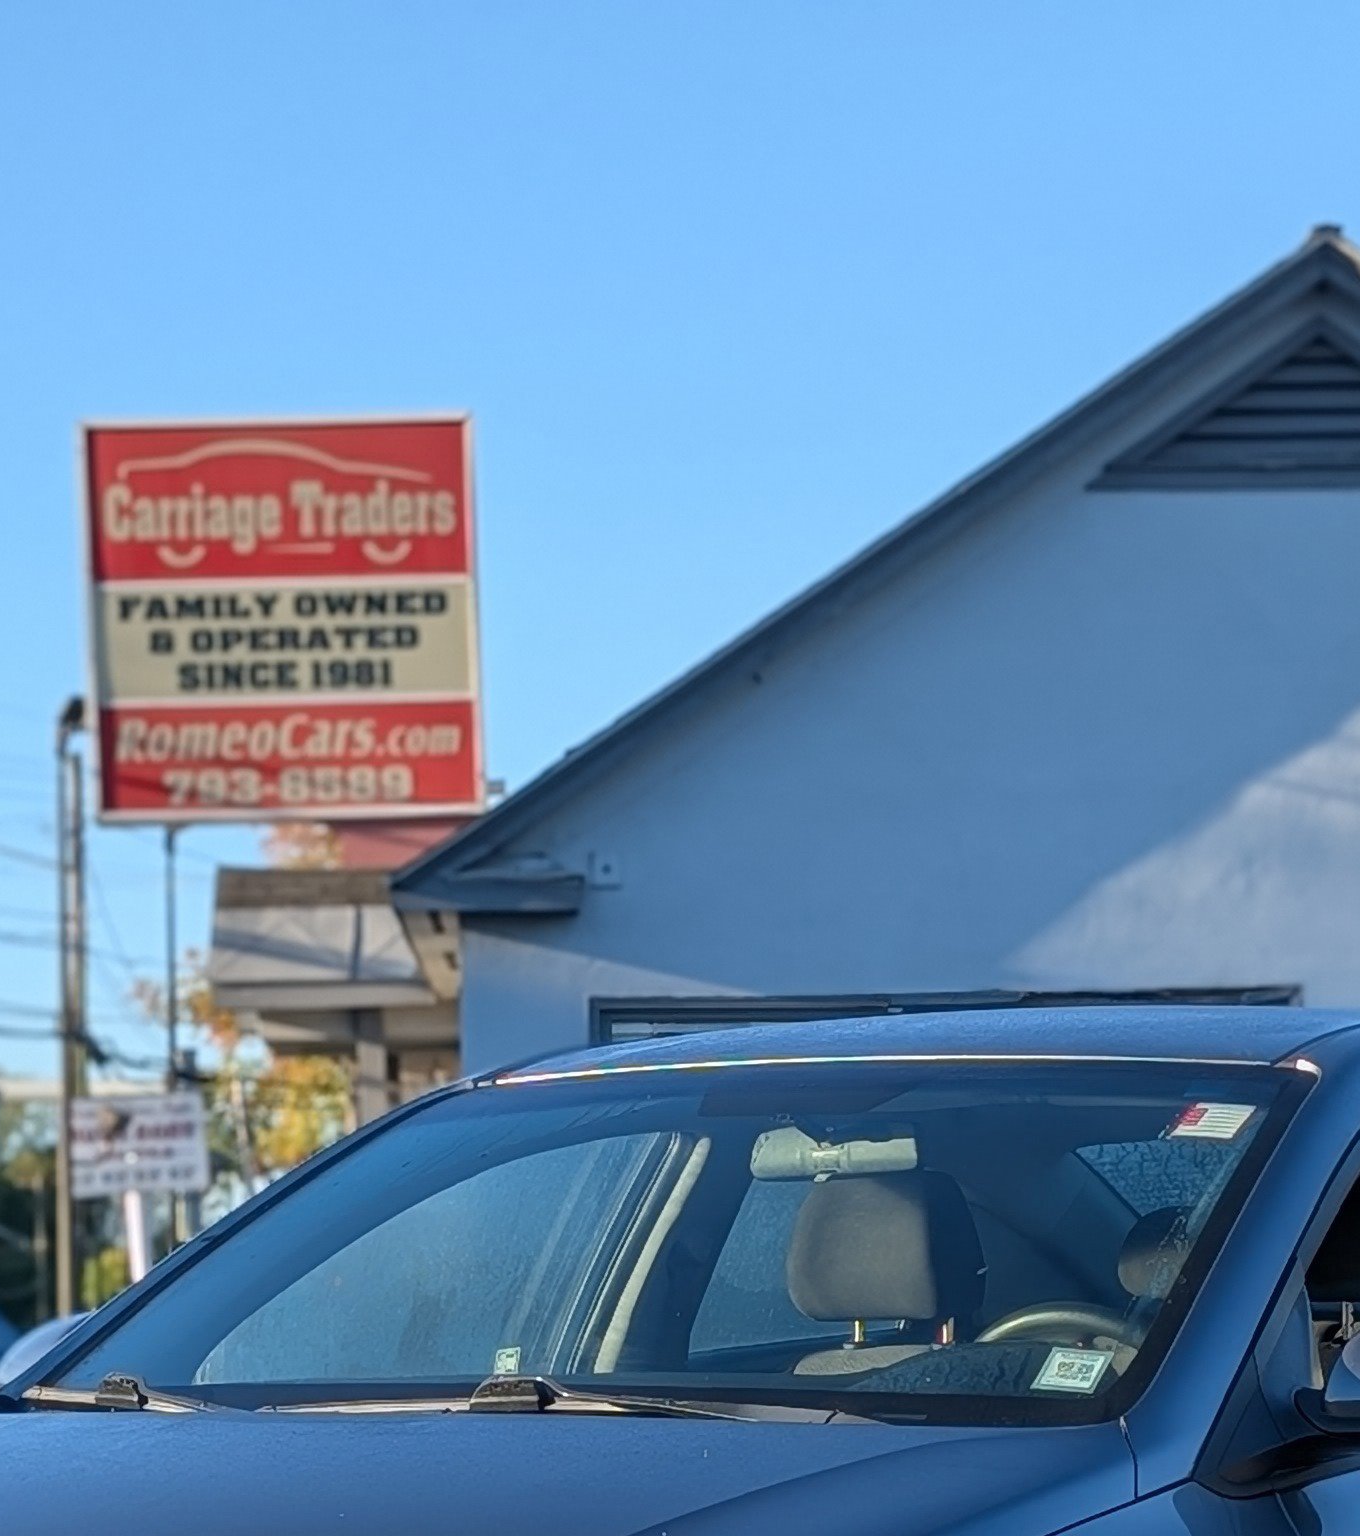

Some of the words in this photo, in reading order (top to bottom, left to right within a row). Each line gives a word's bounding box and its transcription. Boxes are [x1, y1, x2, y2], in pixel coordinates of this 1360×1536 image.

[102, 481, 283, 555] Carriage
[290, 479, 456, 538] Traders
[119, 592, 280, 622] FAMILY
[294, 590, 449, 619] OWNED
[149, 629, 176, 655] &
[190, 625, 421, 655] OPERATED
[177, 661, 300, 692] SINCE
[311, 658, 394, 689] 1981
[115, 713, 462, 764] RomeoCars.com
